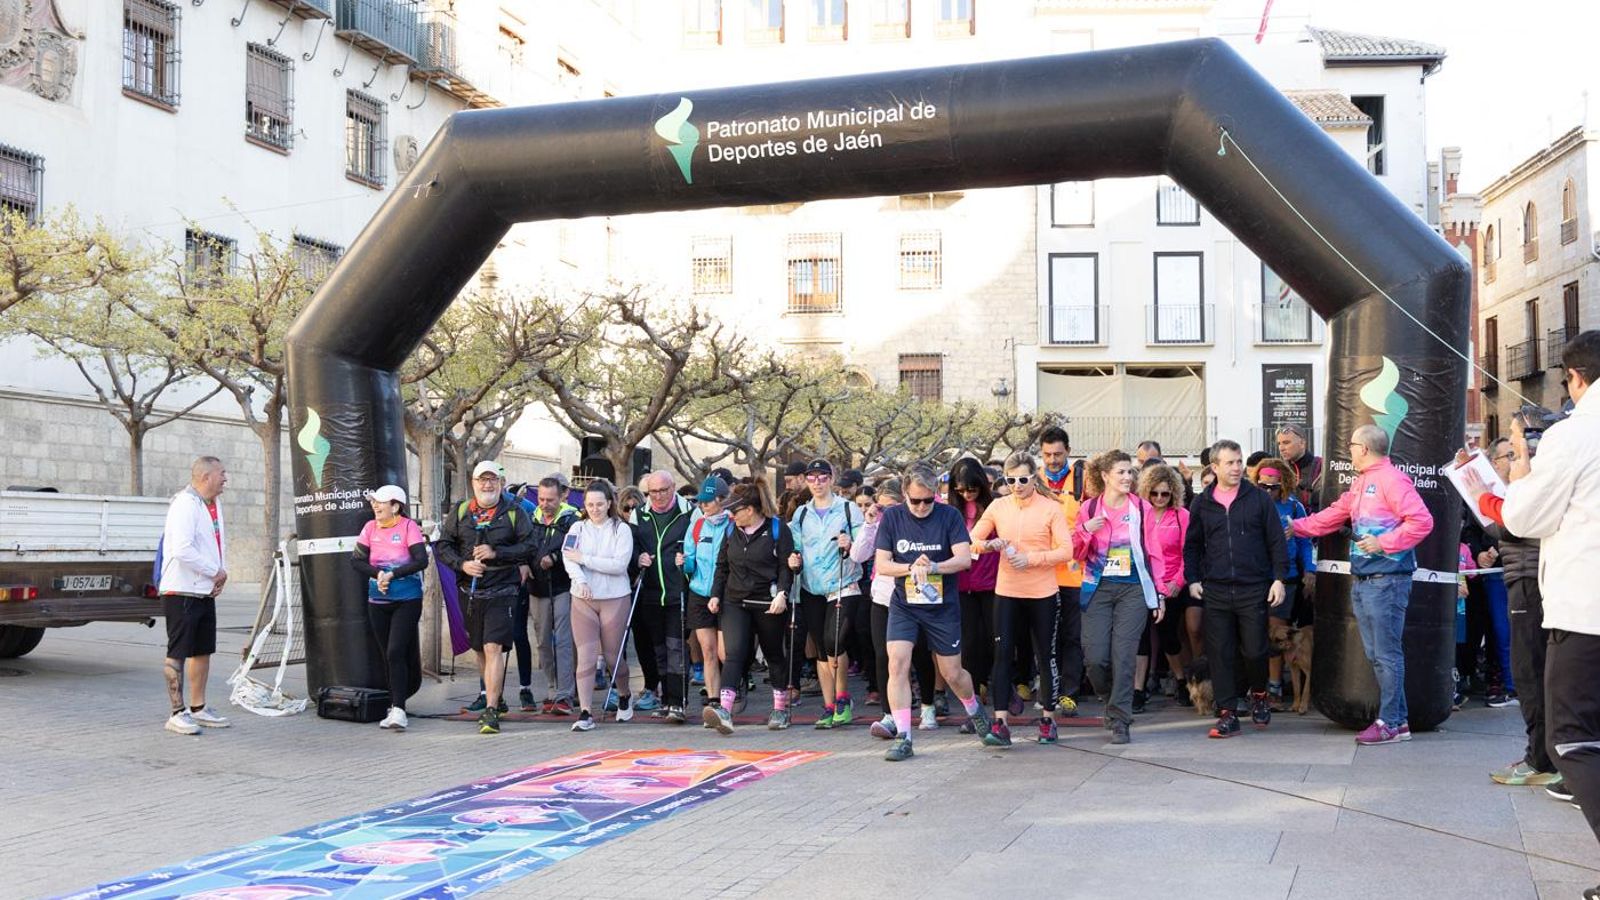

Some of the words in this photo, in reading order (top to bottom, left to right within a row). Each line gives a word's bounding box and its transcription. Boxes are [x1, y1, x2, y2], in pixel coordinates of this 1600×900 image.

[707, 116, 800, 139] Patronato
[807, 104, 904, 130] Municipal
[910, 101, 936, 120] de
[708, 140, 797, 164] Deportes
[803, 135, 828, 154] de
[833, 130, 883, 152] Jaén
[1330, 460, 1356, 471] Patro
[1413, 476, 1438, 489] Jaén
[315, 489, 360, 500] Municipal
[325, 502, 337, 510] de
[339, 500, 363, 510] Jaén
[909, 542, 942, 551] Avanza
